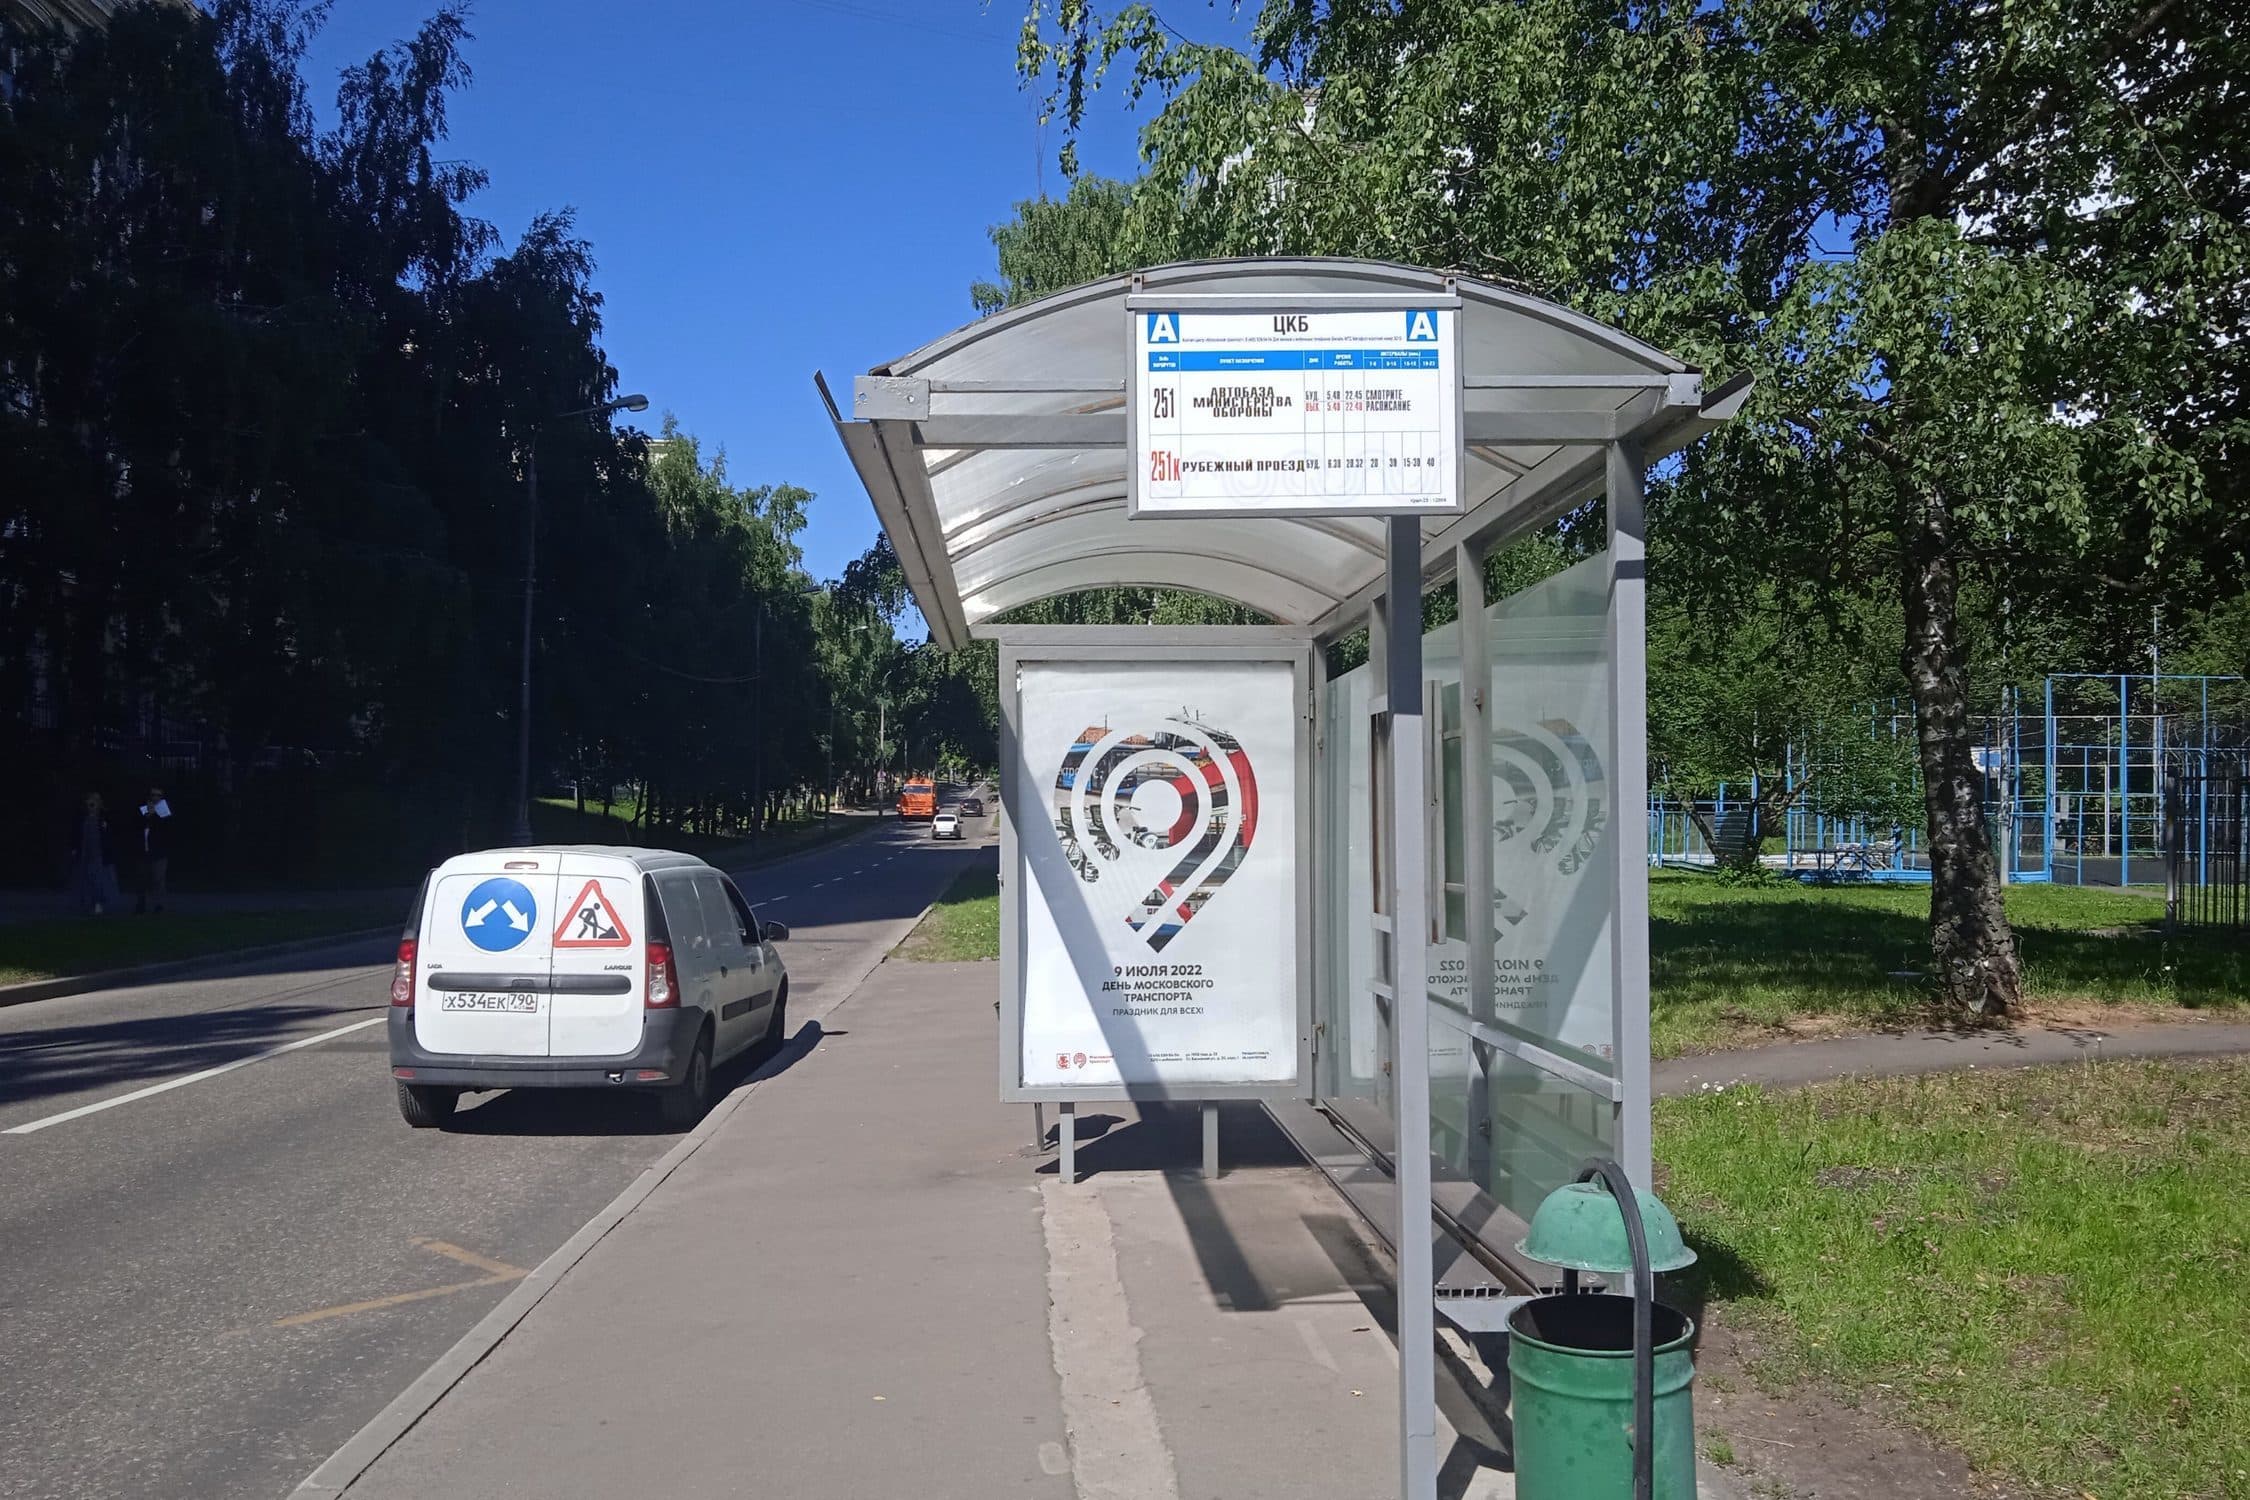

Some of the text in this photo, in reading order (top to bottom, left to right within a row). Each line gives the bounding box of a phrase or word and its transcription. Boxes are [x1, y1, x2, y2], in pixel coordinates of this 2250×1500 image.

[1150, 313, 1178, 342] А
[1273, 315, 1309, 335] ЦКБ
[1408, 311, 1437, 340] А
[1210, 386, 1275, 398] АВТОБАЗА
[1365, 389, 1402, 400] СМОТРИТЕ
[1153, 388, 1175, 418] 251
[1193, 396, 1292, 408] МИНИСТЕРСТВА
[1365, 400, 1411, 411] РАСПИСАНИЕ
[1213, 406, 1273, 418] ОБОРОНЫ
[1182, 459, 1305, 473] РУБЕЖНЫЙ ПРОЕЗД
[1114, 965, 1202, 977] 9 ИЮЛЯ 2022
[1102, 979, 1214, 992] ДЕНЬ МОСКОВСКОГО
[1124, 992, 1193, 1003] ТРАНСПОРТА
[1112, 1007, 1204, 1016] ПРАЗДНИК ДЛЯ ВСЕХ!
